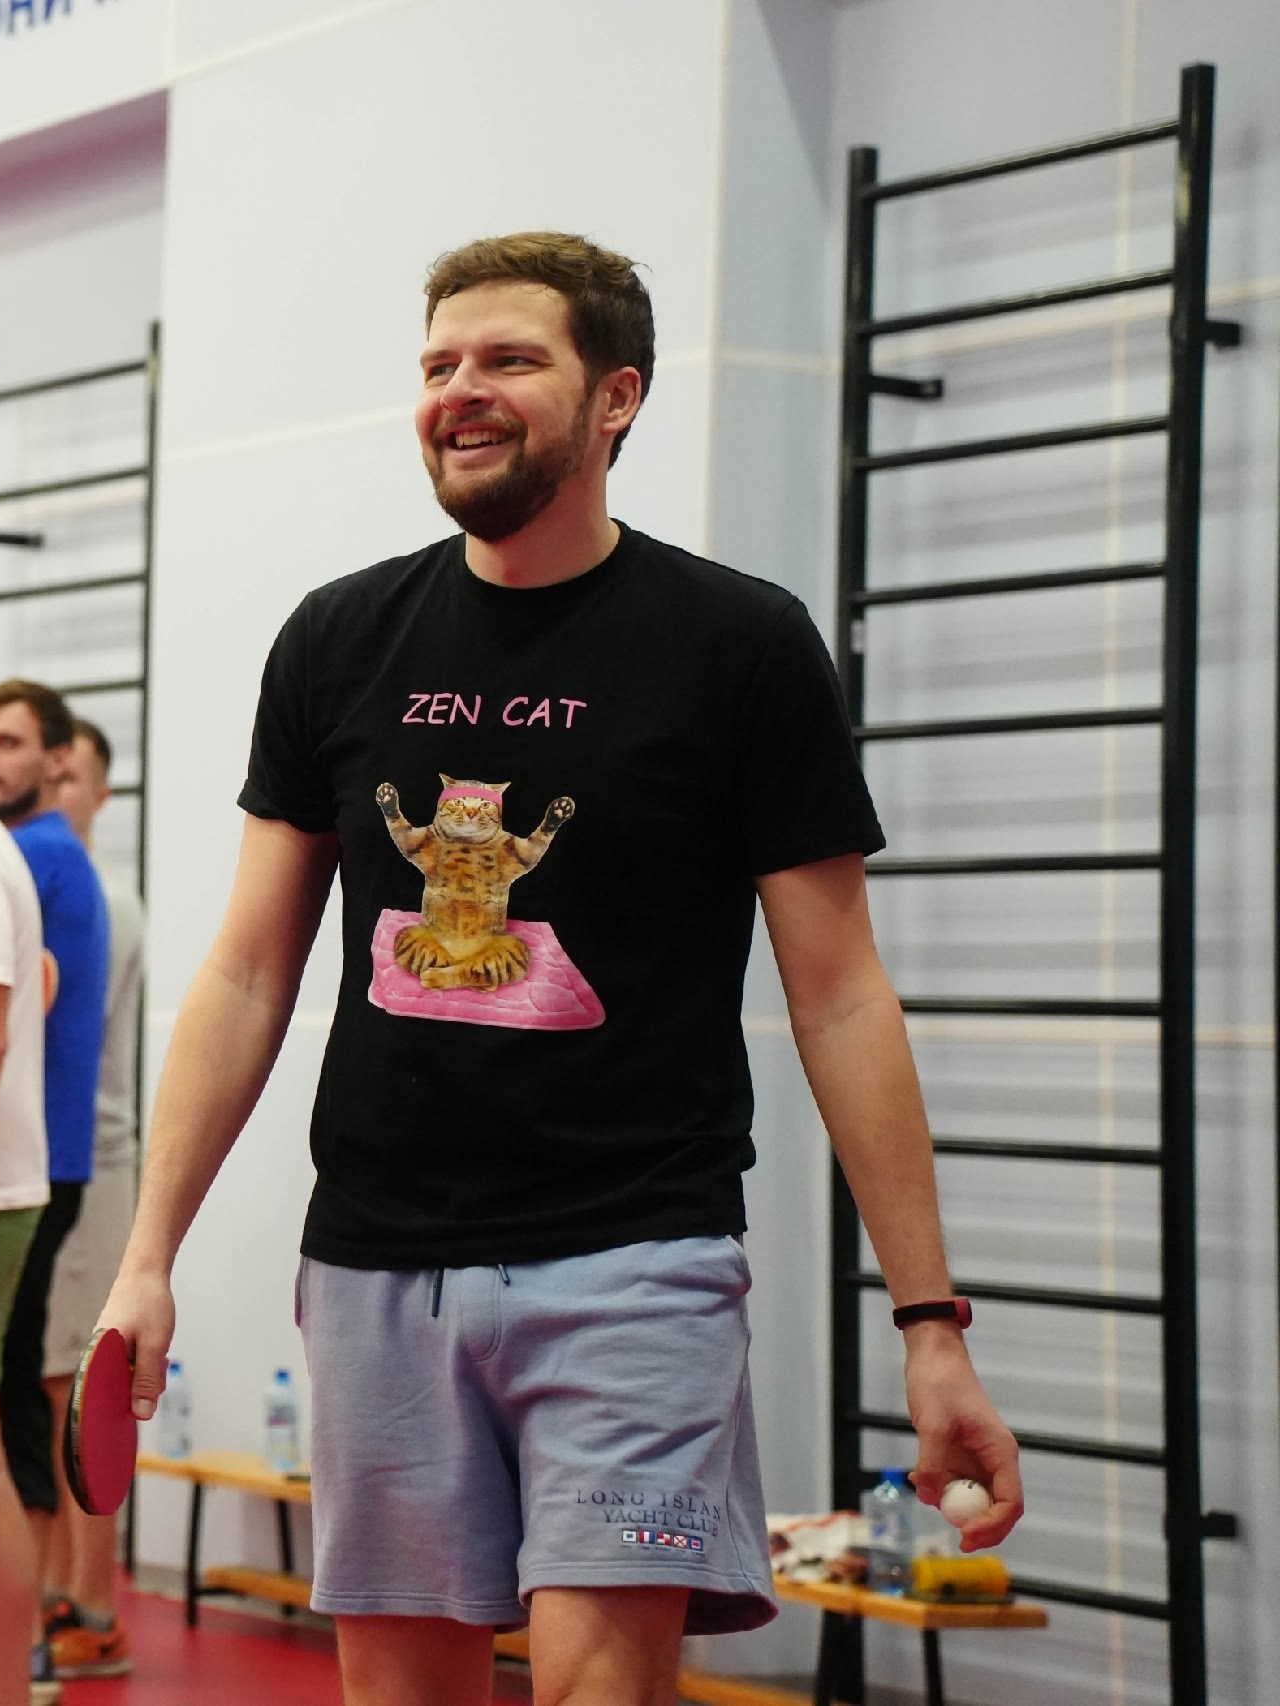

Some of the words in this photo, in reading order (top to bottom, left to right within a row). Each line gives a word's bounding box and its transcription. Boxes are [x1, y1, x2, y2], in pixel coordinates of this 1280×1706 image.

[402, 693, 482, 725] ZEN
[502, 696, 587, 728] CAT
[576, 1489, 645, 1507] LONG
[659, 1492, 721, 1523] ISLAN
[603, 1508, 674, 1526] YACHT
[676, 1514, 719, 1538] CLUB
